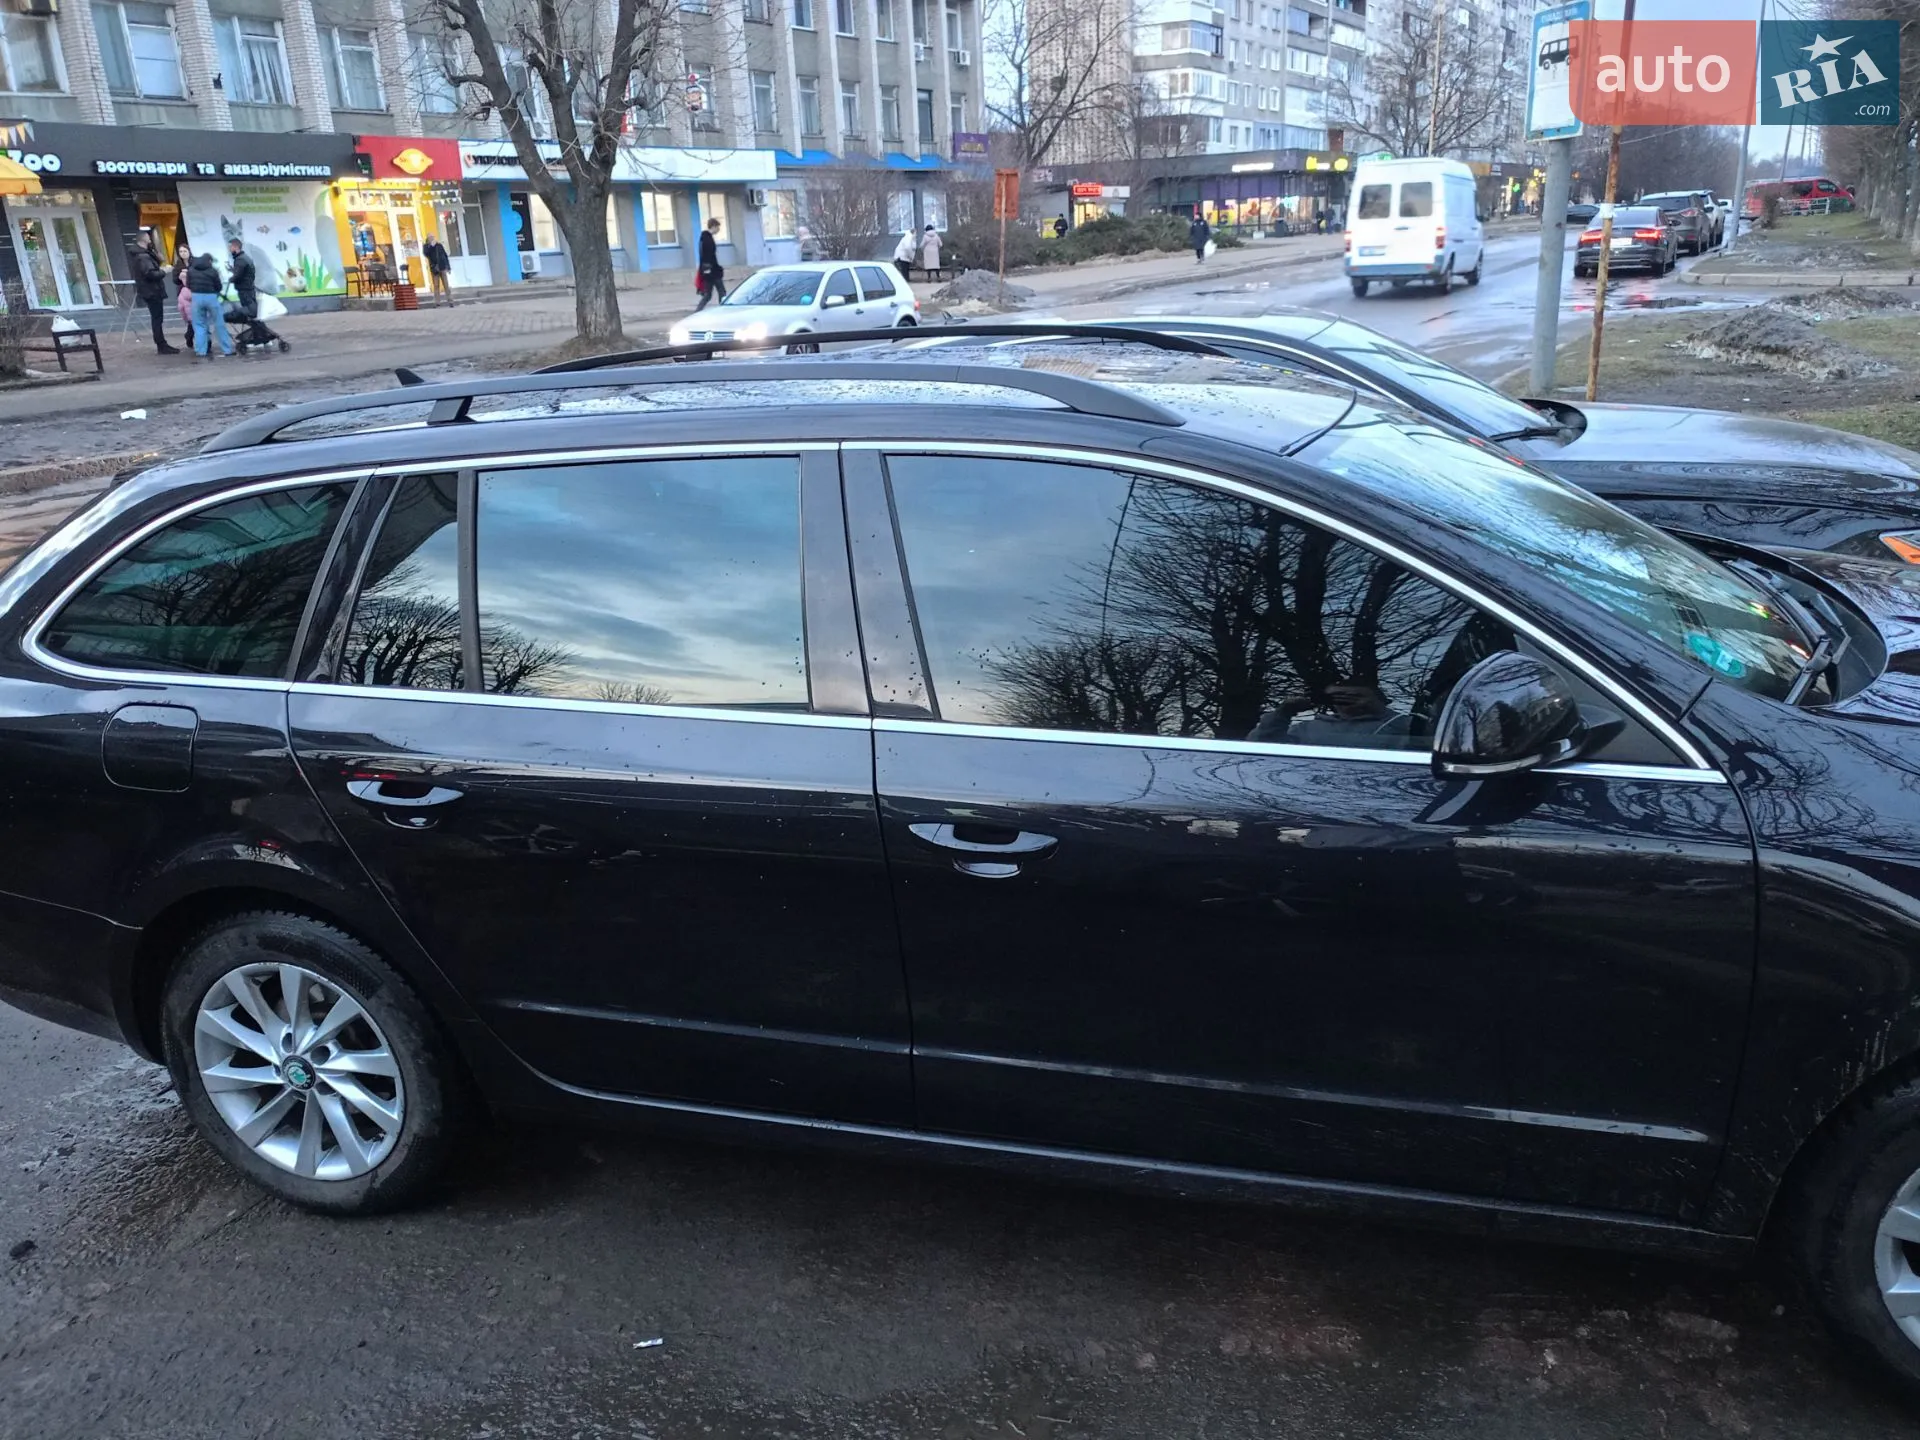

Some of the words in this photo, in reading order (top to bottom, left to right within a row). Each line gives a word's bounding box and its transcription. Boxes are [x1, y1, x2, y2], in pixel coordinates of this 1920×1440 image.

[96, 160, 188, 175] зоотовари
[197, 162, 216, 174] та
[223, 162, 331, 177] акваріумістика
